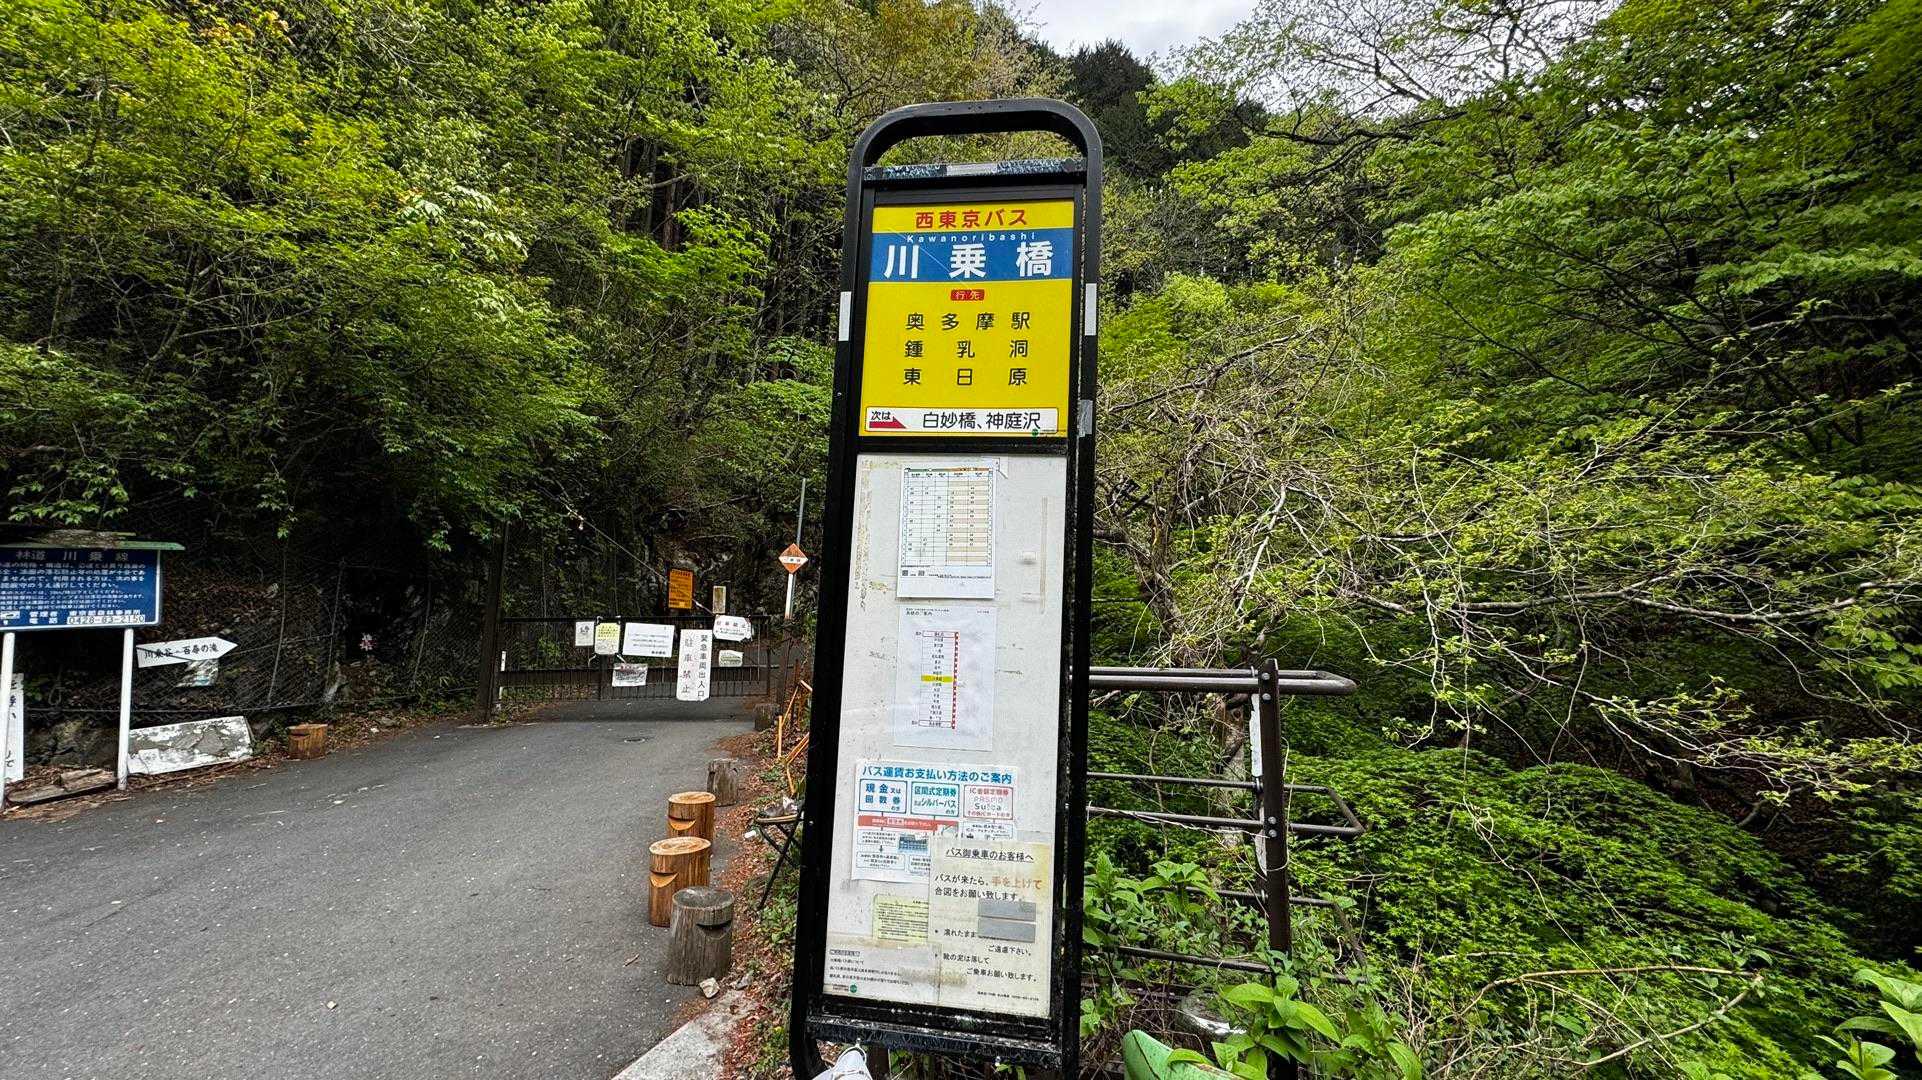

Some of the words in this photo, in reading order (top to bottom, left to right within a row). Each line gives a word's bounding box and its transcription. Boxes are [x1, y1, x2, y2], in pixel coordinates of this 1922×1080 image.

[915, 208, 1028, 229] 西東京バス
[907, 232, 1035, 243] Kawanoribashi
[883, 241, 1054, 279] 川乗橋
[954, 290, 981, 300] 行先
[905, 311, 1030, 331] 奥多摩駅
[904, 339, 1029, 359] 鍾乳洞
[903, 367, 1028, 386] 東日原
[871, 410, 891, 421] 次は
[922, 411, 1041, 430] 白妙橋、神庭沢
[697, 634, 708, 697] 緊急車両出入口
[862, 765, 1012, 785] バス運賃お支払い方法のご案内
[946, 848, 1034, 861] バス御乗車のお客様へ
[935, 886, 1022, 902] 合図をお願い致します。
